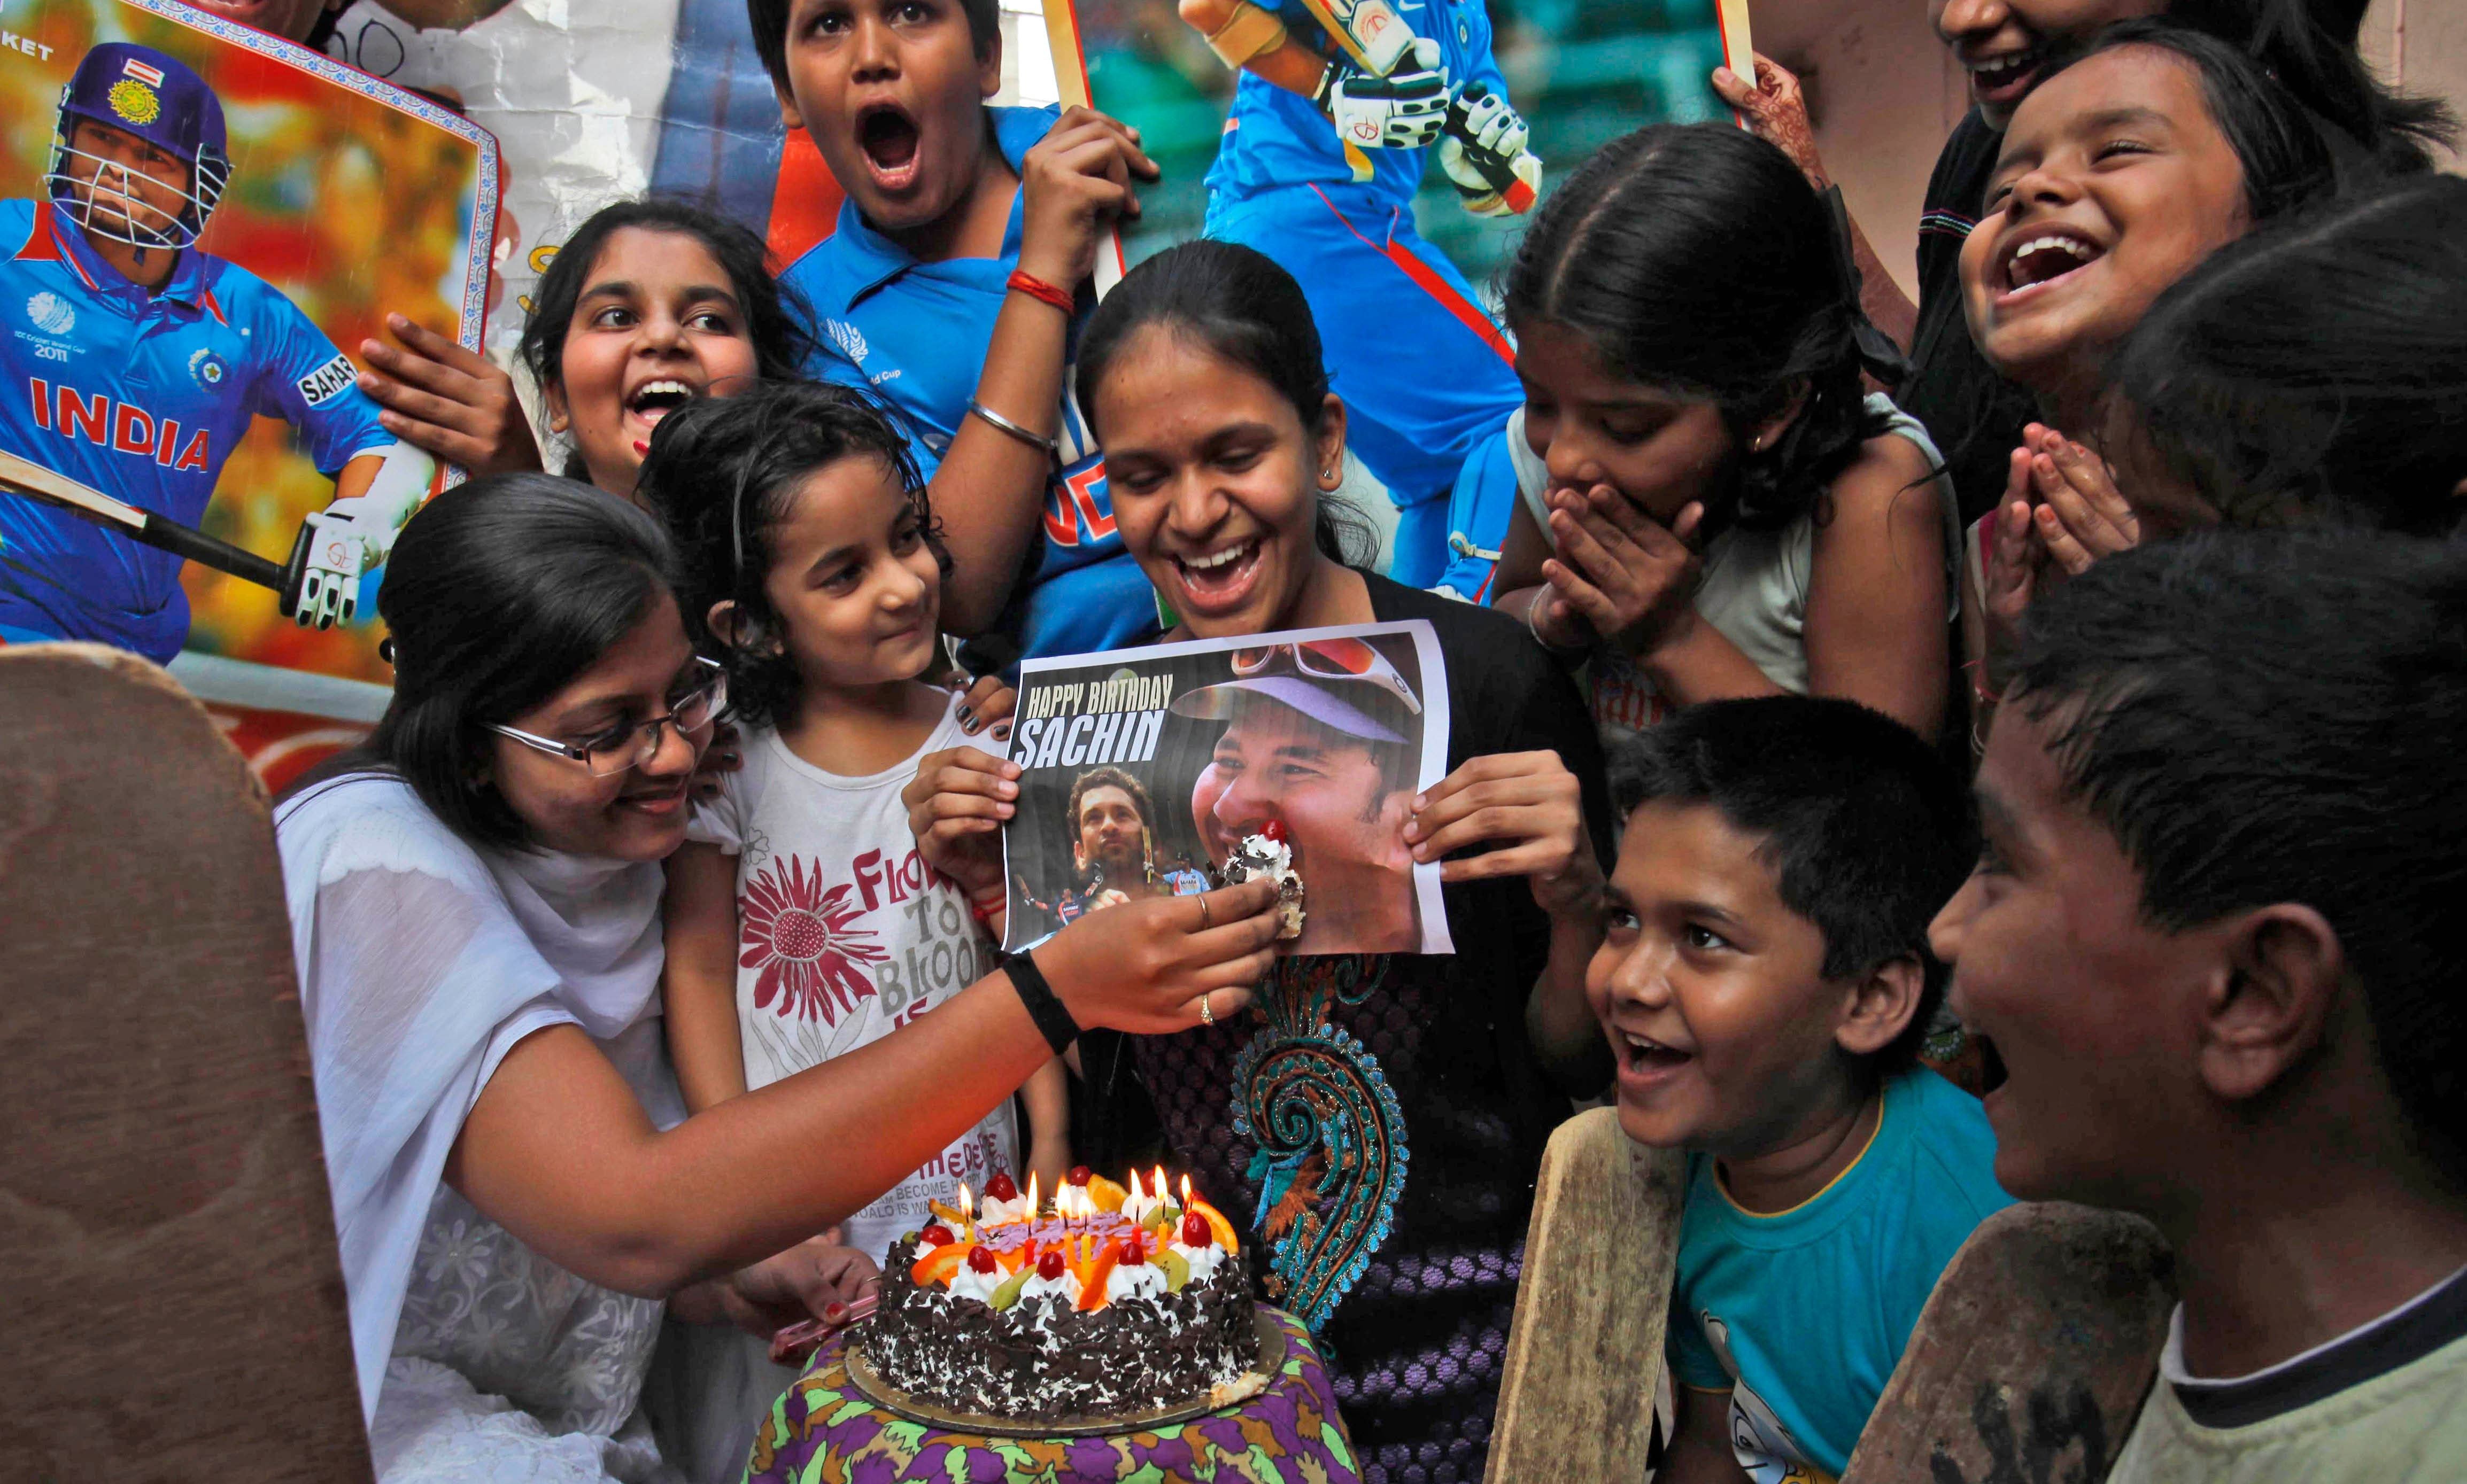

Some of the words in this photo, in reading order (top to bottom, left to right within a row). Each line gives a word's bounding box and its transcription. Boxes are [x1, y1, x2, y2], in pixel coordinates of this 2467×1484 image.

[34, 344, 68, 363] 2011
[882, 369, 901, 380] Cup
[30, 376, 210, 473] INDIA
[1026, 683, 1084, 720] HAPPY
[1086, 673, 1173, 715] BIRTHDAY
[1014, 709, 1165, 771] SACHIN
[903, 895, 961, 944] TO
[896, 1180, 949, 1200] BECOME
